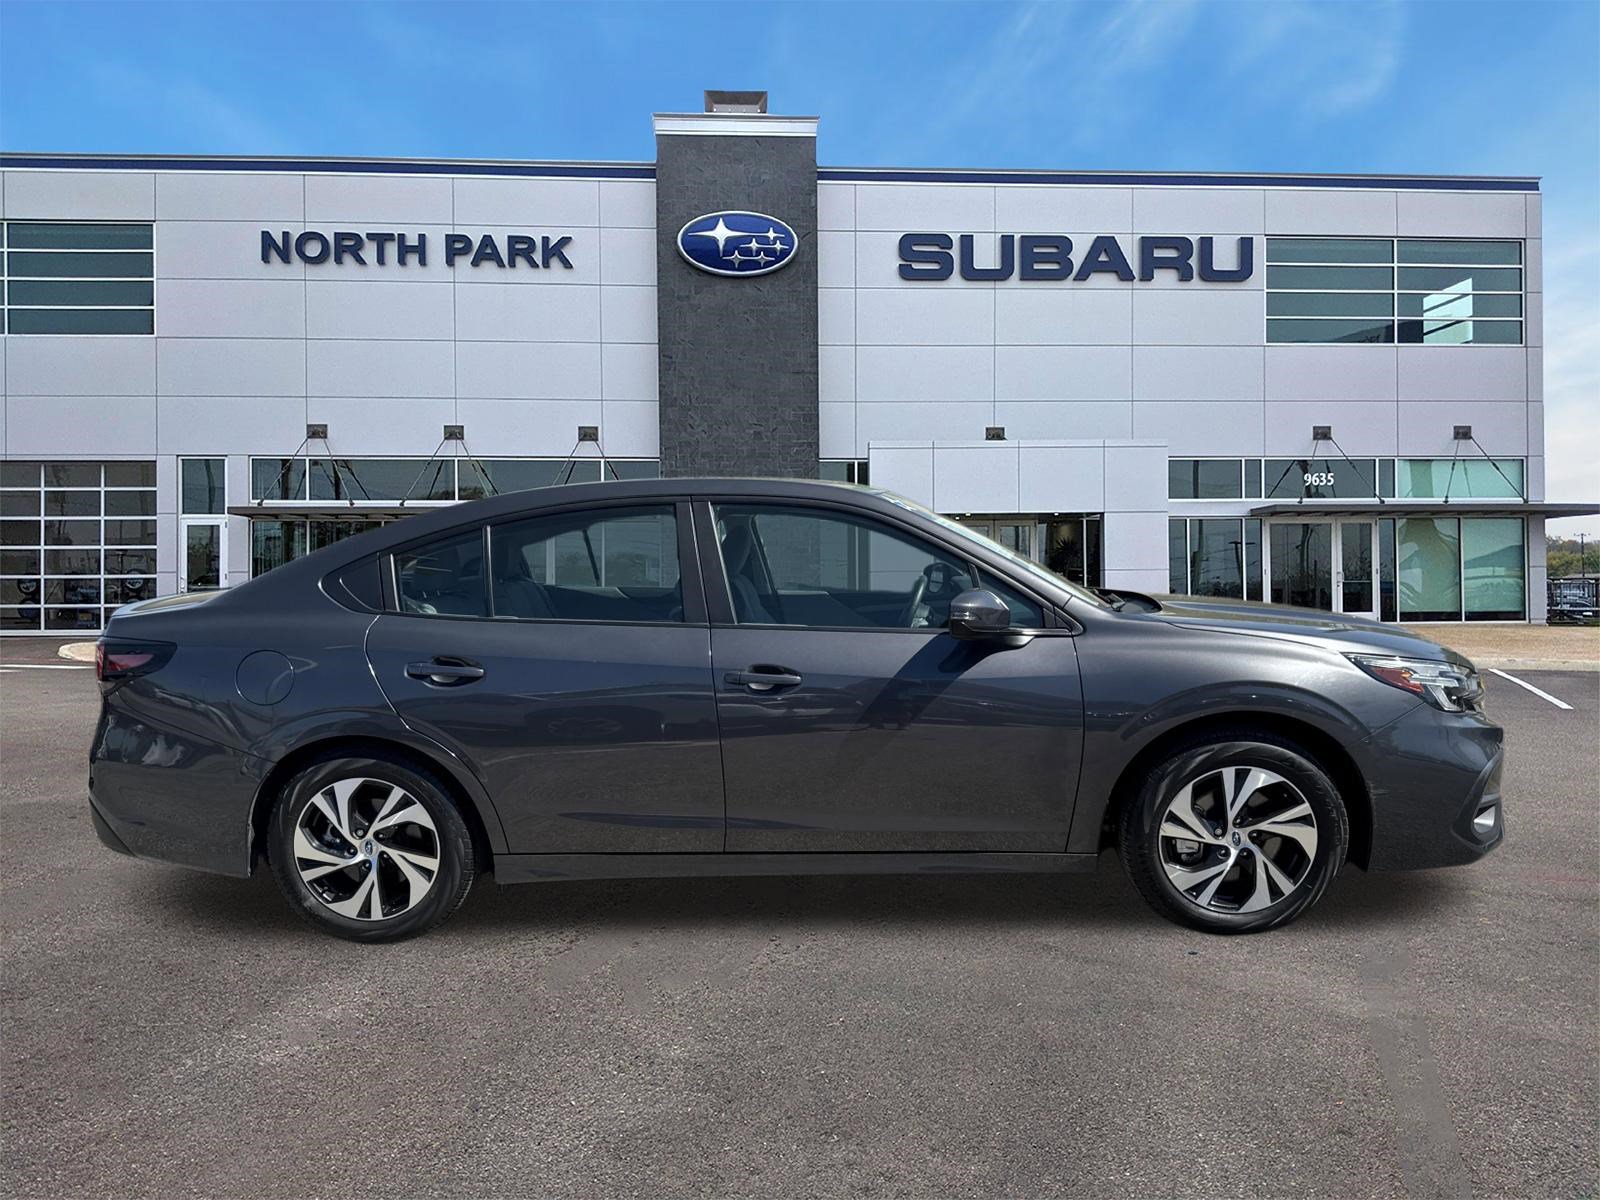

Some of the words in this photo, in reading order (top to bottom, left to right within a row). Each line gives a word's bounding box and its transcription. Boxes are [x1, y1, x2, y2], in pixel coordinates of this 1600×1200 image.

[261, 230, 427, 265] NORTH
[445, 234, 574, 269] PARK
[898, 232, 1253, 282] SUBARU
[1303, 472, 1335, 486] 9635
